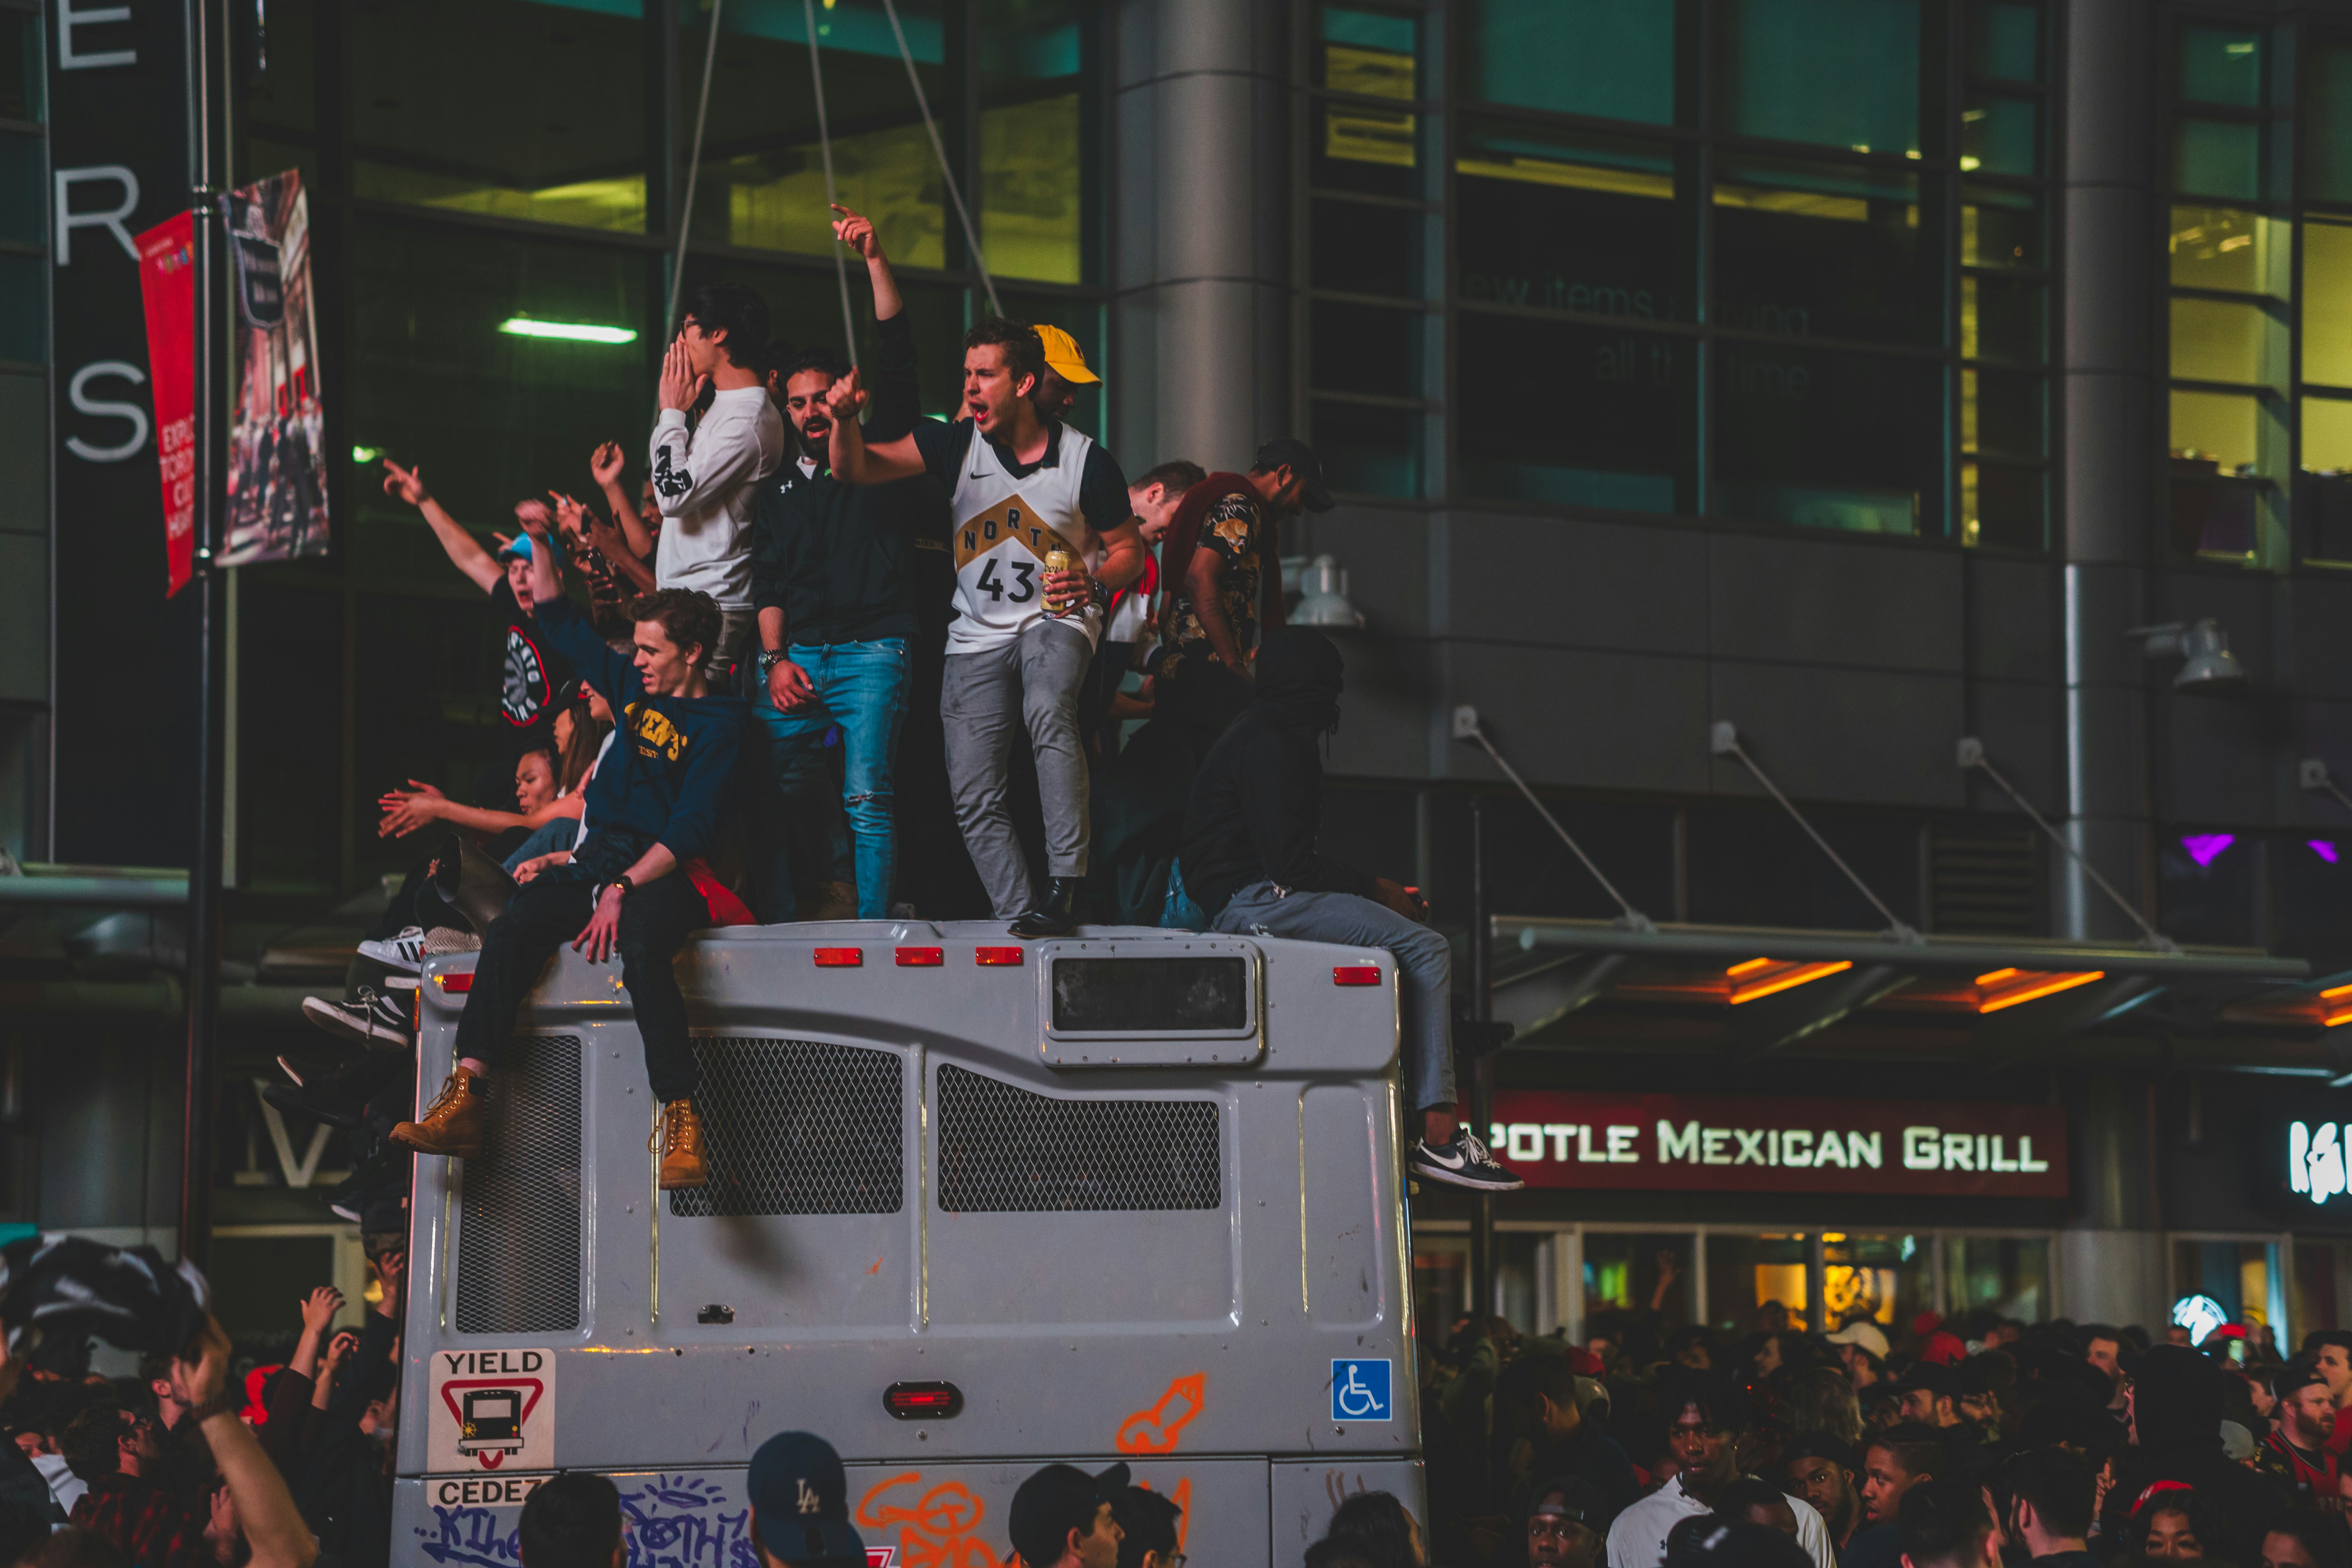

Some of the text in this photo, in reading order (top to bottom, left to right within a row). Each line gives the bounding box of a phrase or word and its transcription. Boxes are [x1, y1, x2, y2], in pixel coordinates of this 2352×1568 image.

[976, 558, 1035, 603] 43
[1466, 1119, 2049, 1172] POTLE MEXICAN GRILL
[444, 1351, 543, 1374] YIELD
[797, 1478, 820, 1514] LA
